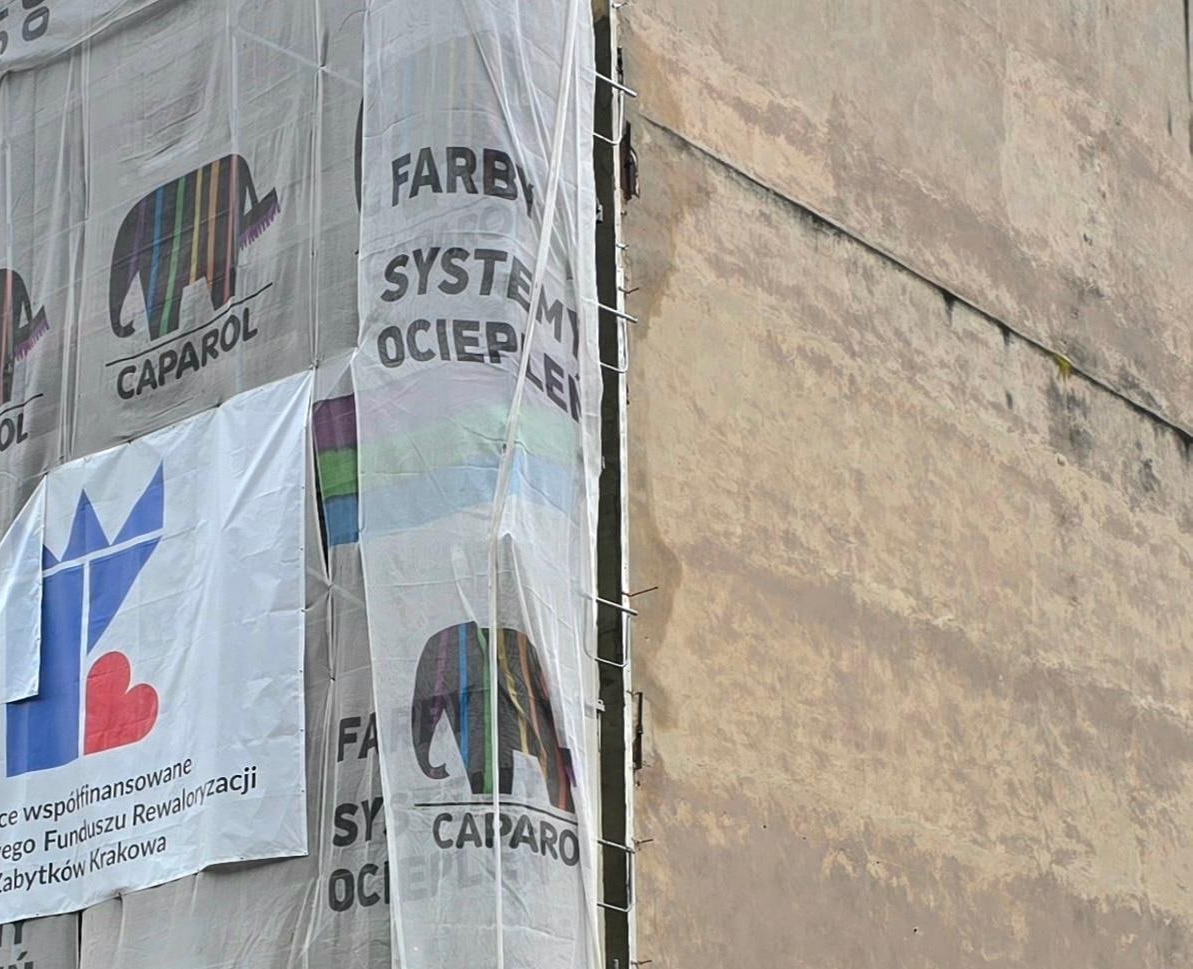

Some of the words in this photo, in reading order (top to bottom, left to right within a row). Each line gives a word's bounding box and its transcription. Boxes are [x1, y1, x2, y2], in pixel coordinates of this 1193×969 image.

[116, 308, 258, 399] CAPAROL
[23, 757, 192, 822] współfinansowane
[44, 815, 126, 852] Funduszu
[132, 765, 258, 826] Rewaloryzacji
[332, 797, 387, 847] SY
[90, 834, 167, 872] Krakowa
